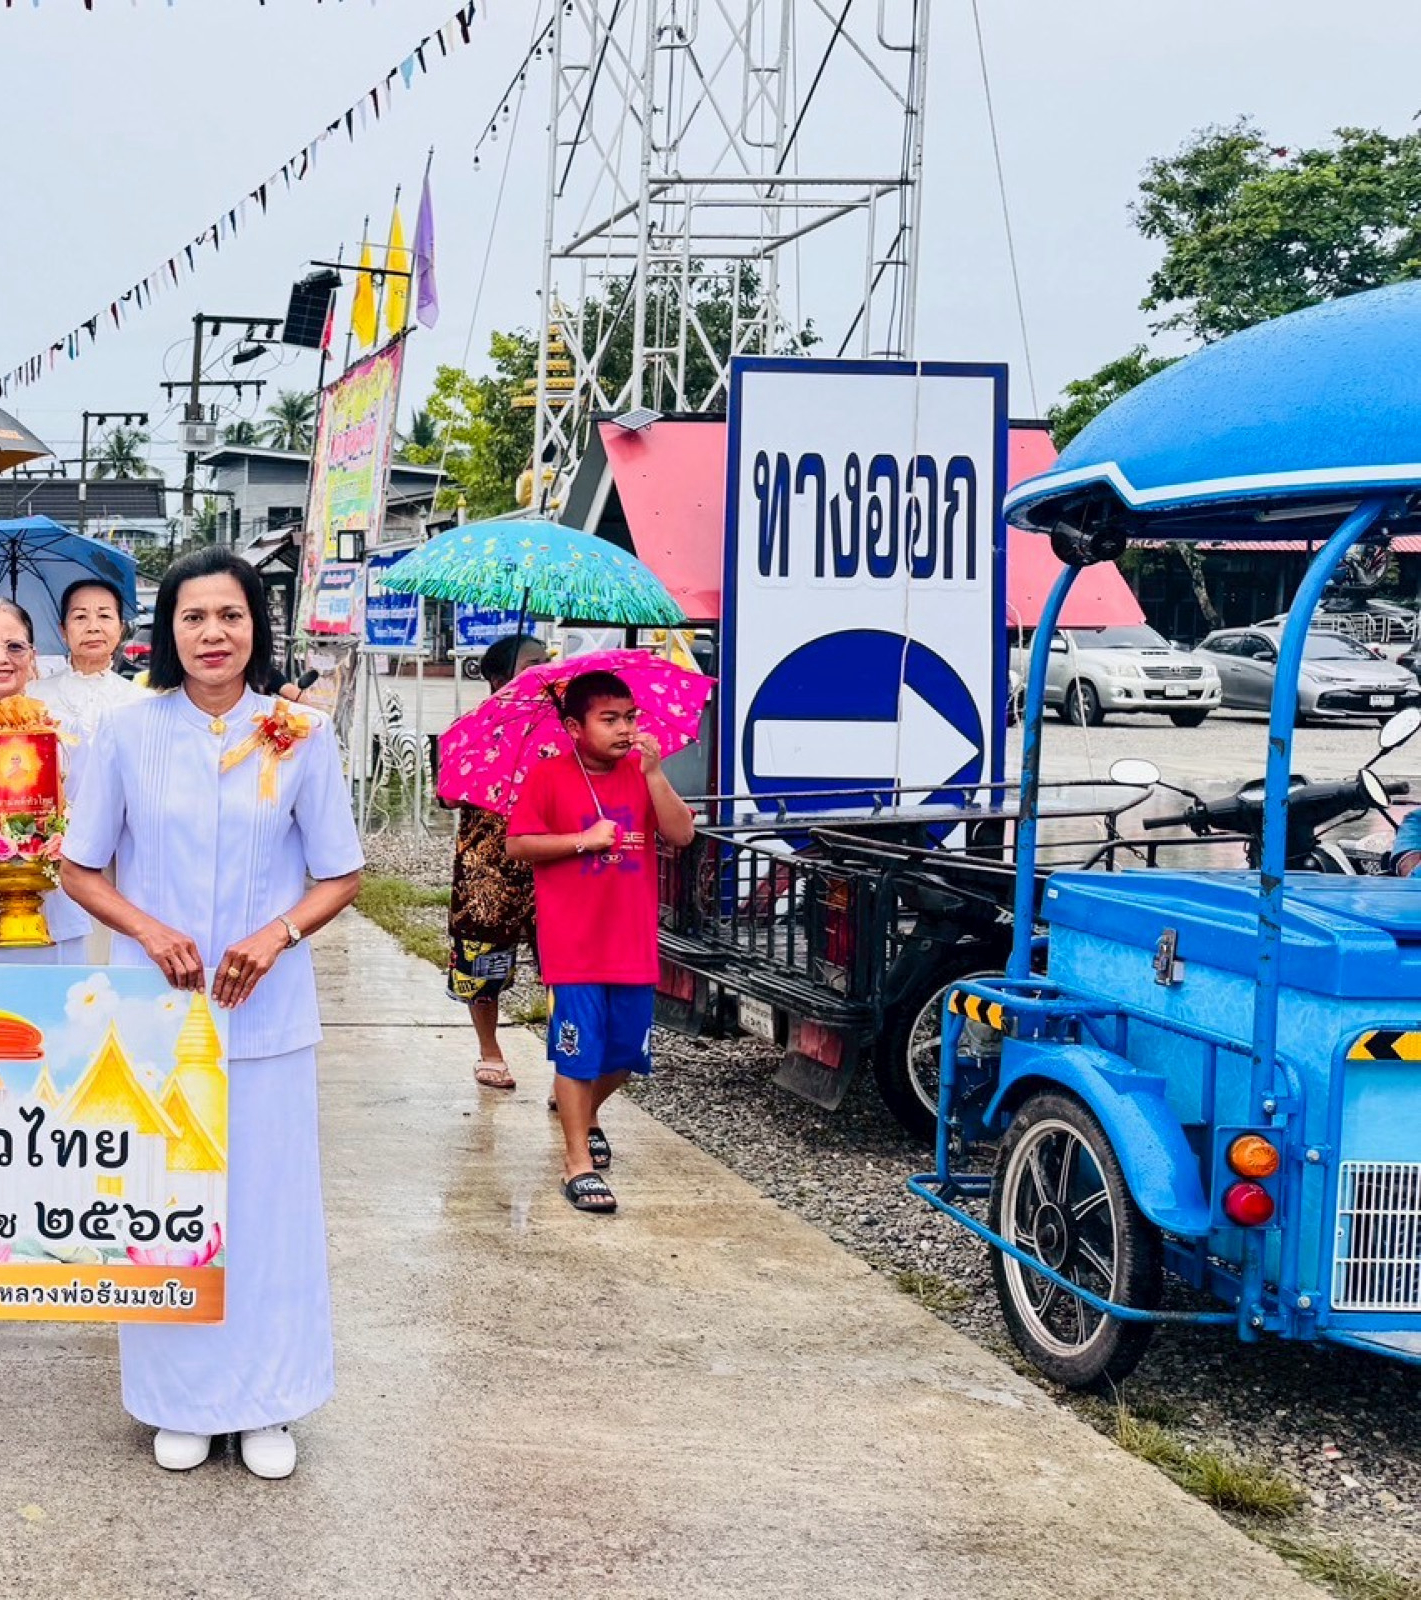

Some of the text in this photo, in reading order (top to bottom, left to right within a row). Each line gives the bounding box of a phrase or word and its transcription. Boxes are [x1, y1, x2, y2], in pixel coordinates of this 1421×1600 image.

[753, 449, 977, 580] ทางออก
[34, 1201, 204, 1243] ๒๕๖๘
